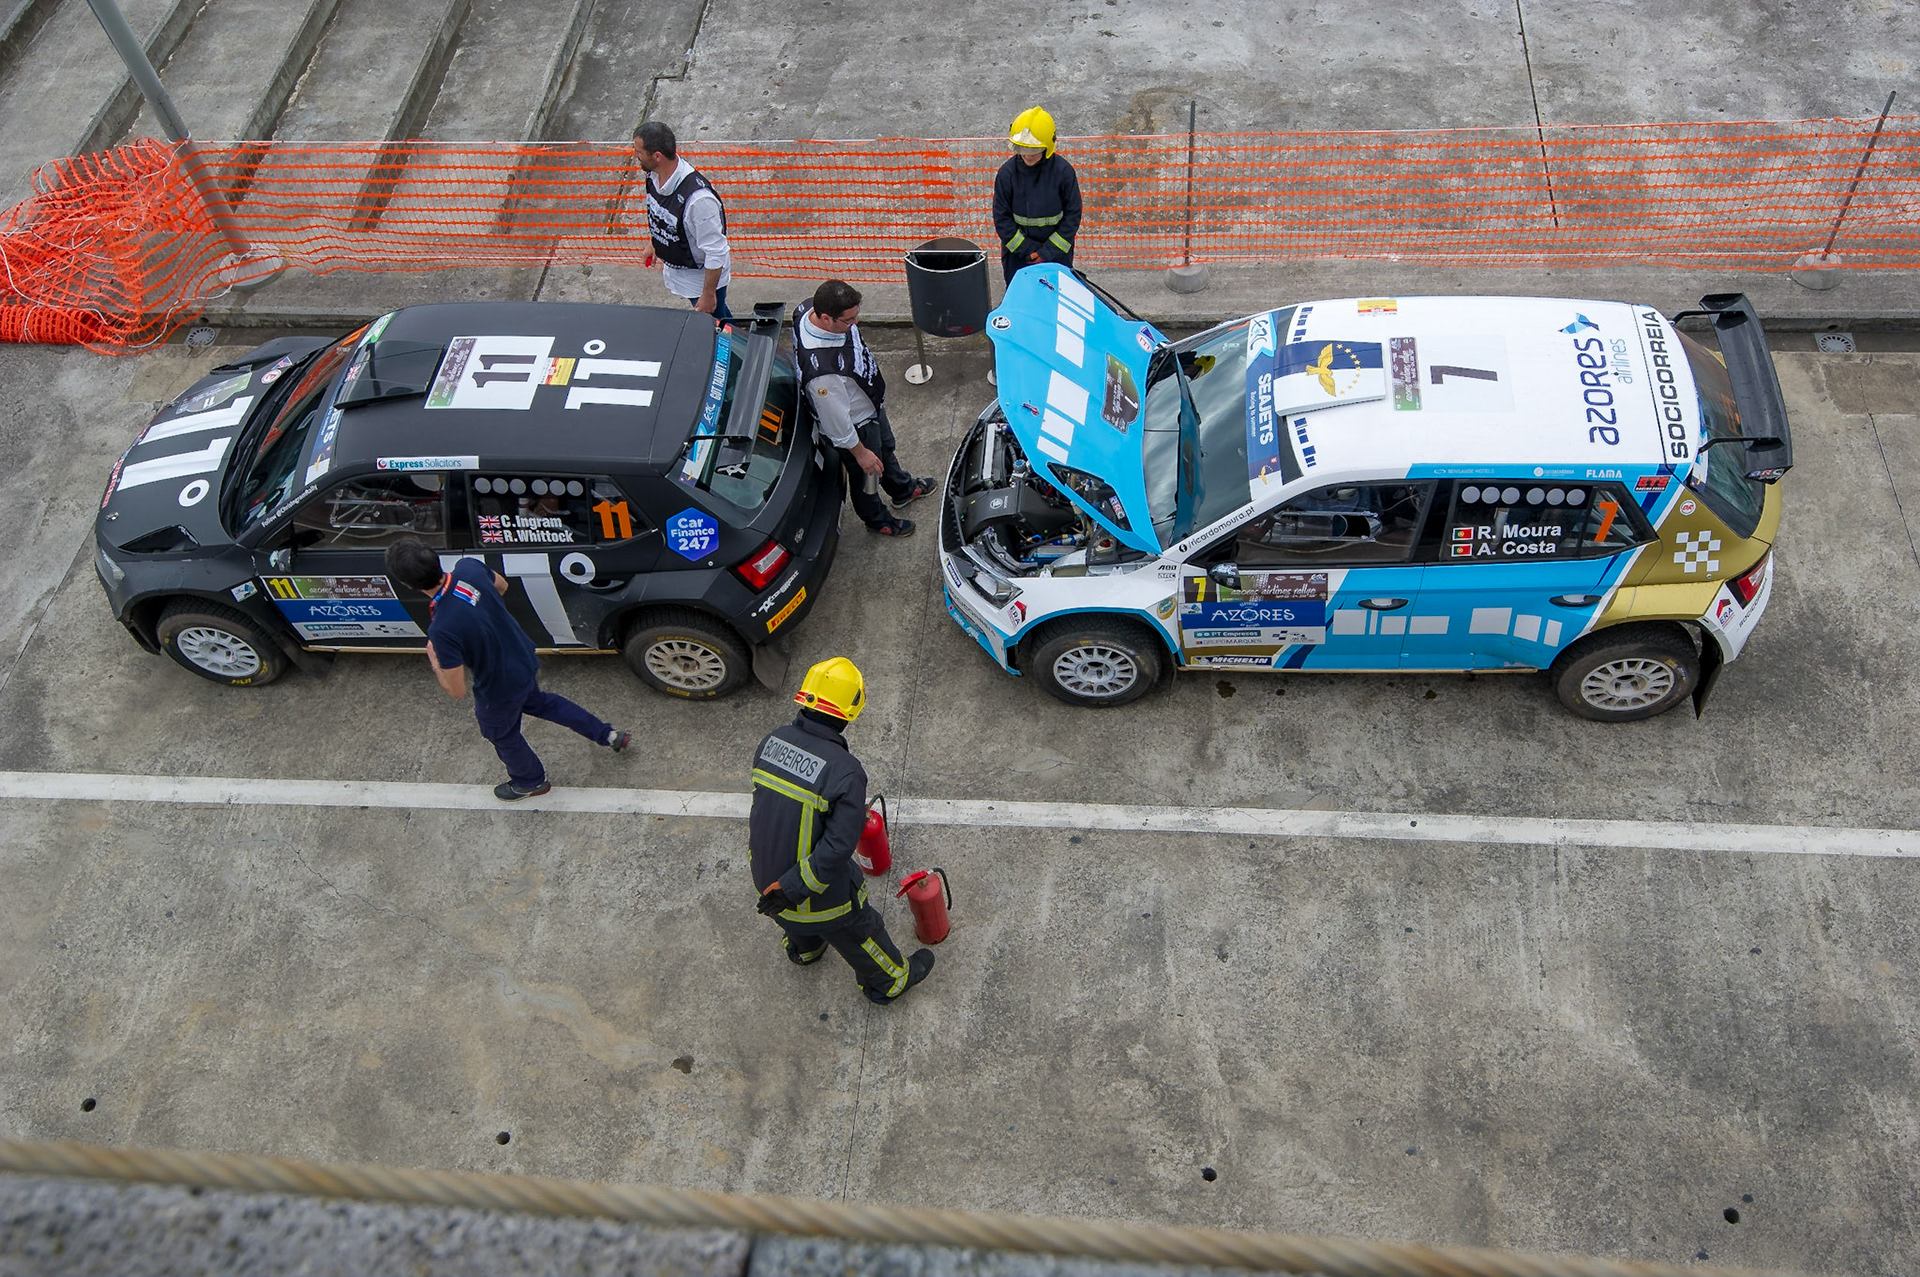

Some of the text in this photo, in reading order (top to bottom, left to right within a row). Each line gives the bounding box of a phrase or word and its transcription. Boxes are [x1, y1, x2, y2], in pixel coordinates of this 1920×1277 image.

[1610, 338, 1633, 385] airlines
[471, 354, 537, 388] 11
[711, 361, 728, 387] TALENT?
[1430, 365, 1498, 385] 7
[1641, 311, 1689, 459] SOCICORREIA
[708, 386, 722, 400] GOT
[1257, 372, 1274, 446] SEAJETS
[389, 457, 462, 471] Express Solicitors
[1586, 469, 1622, 478] FLAMA
[1636, 476, 1671, 487] ETS
[261, 515, 278, 528] Follow
[500, 514, 562, 530] C.Ingram
[593, 501, 633, 539] 11
[678, 517, 704, 529] Car
[1594, 501, 1619, 542] 7
[503, 528, 574, 544] R.Whittock
[670, 525, 715, 538] Finance
[1478, 524, 1562, 539] R. Moura
[679, 538, 710, 551] 247
[1477, 541, 1557, 555] A. Costa
[270, 578, 297, 599] 11
[1193, 577, 1206, 602] 7
[1261, 584, 1291, 595] airlines
[309, 604, 382, 617] AZORES
[1211, 608, 1296, 622] AZORES
[1719, 607, 1733, 625] ERA
[1222, 630, 1259, 638] Empresas
[1211, 656, 1269, 665] MICHELIN
[763, 741, 818, 778] BOMBEIROS
